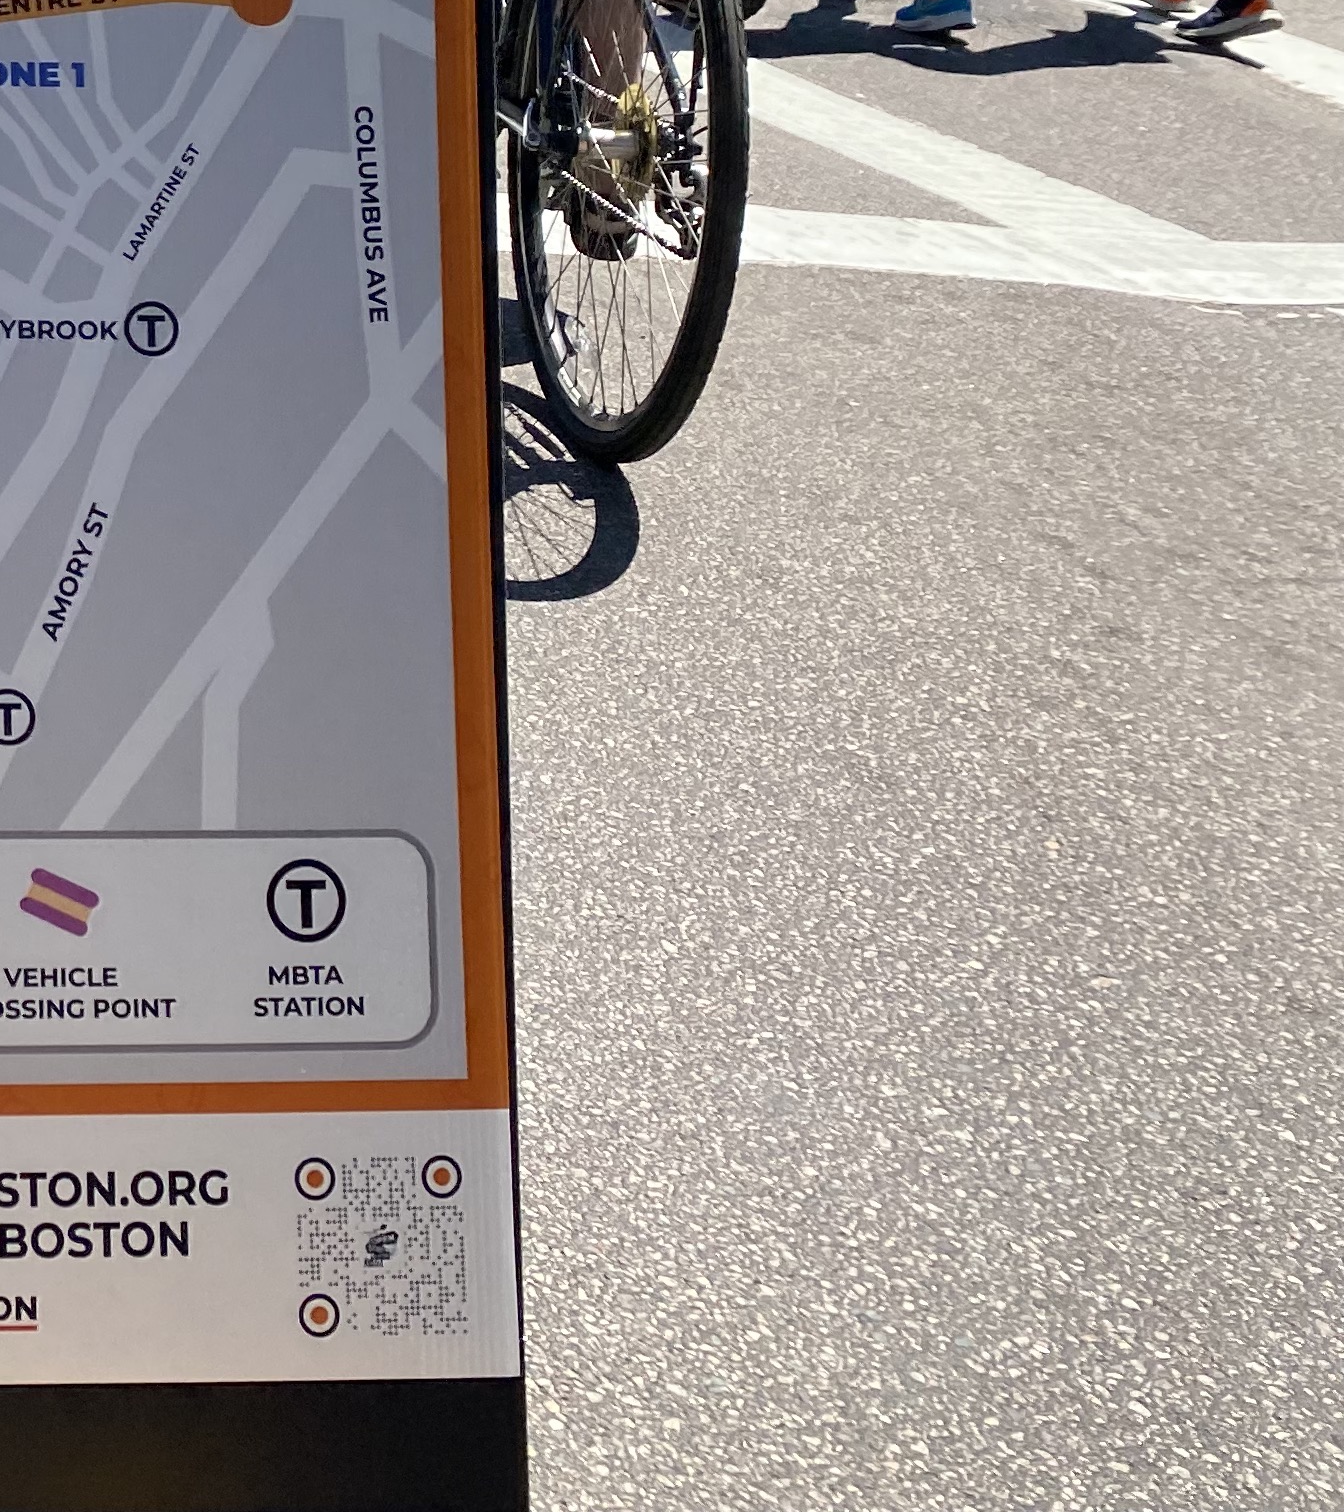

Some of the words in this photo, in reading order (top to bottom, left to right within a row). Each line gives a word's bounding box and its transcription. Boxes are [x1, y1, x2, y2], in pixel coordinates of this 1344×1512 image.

[71, 62, 85, 88] 1
[354, 106, 384, 261] COLUMBUS
[122, 166, 187, 261] LAMARTINE
[179, 142, 200, 168] ST
[366, 267, 389, 323] AVE
[42, 538, 94, 642] AMORY
[83, 502, 110, 538] ST
[3, 967, 118, 988] VEHICLE
[268, 965, 343, 986] MBTA
[94, 998, 176, 1019] POINT
[253, 997, 366, 1017] STATION
